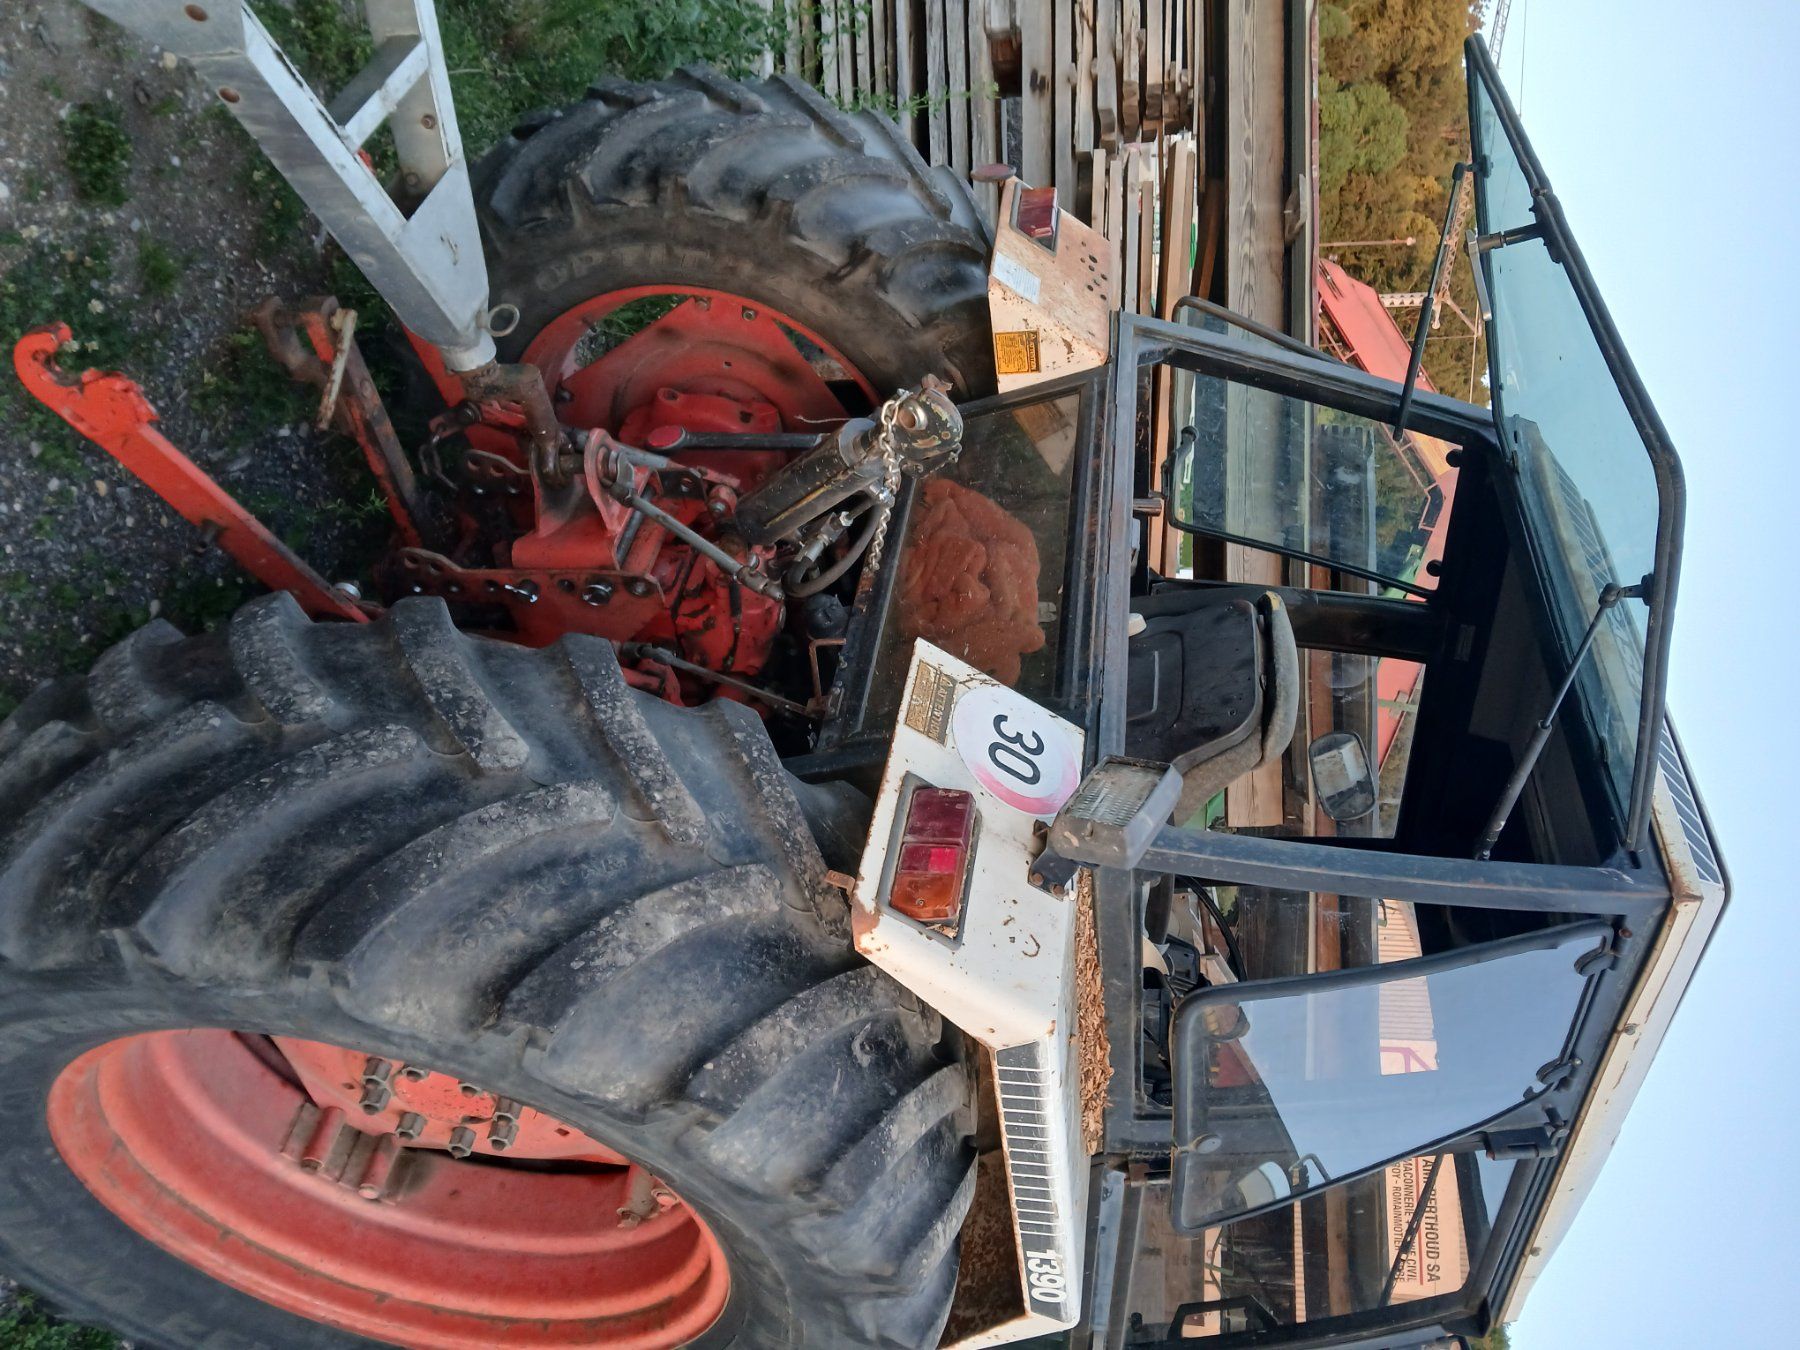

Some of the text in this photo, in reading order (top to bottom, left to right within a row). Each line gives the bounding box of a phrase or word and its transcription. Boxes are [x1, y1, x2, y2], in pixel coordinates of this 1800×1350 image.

[988, 714, 1045, 785] 30
[1026, 1249, 1067, 1303] 1390
[1407, 1258, 1417, 1283] CIVIL
[1426, 1264, 1441, 1283] SA
